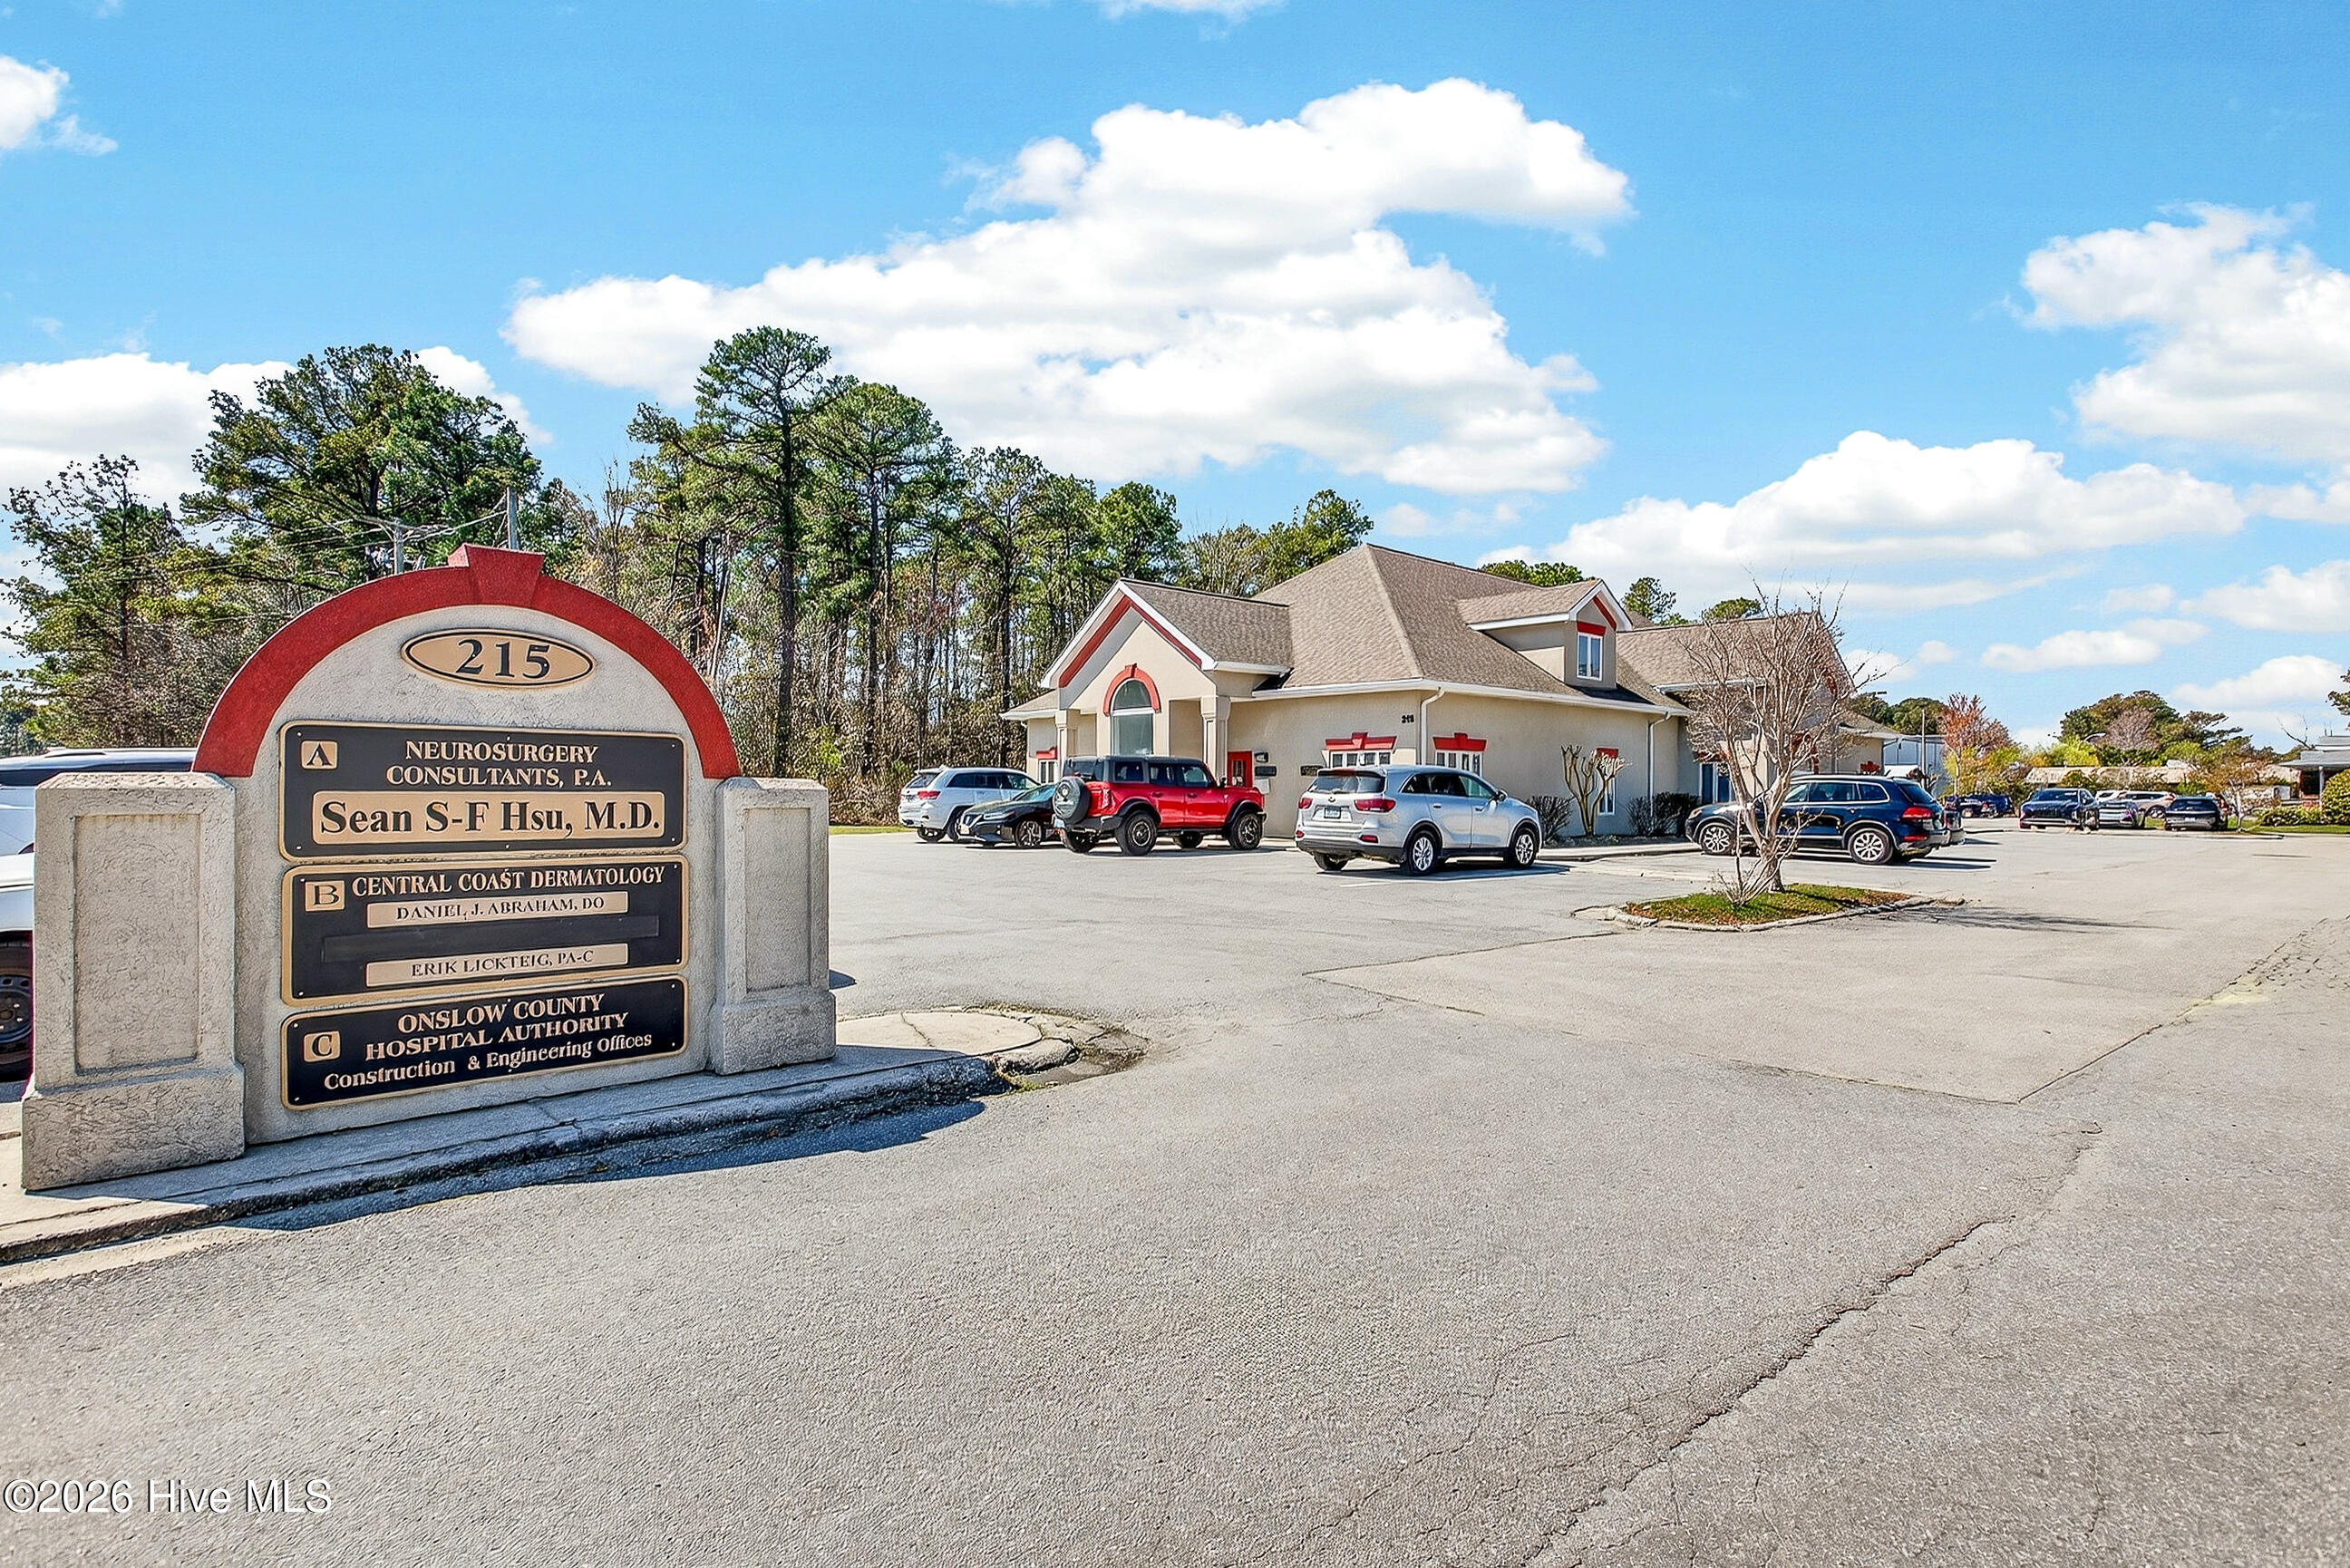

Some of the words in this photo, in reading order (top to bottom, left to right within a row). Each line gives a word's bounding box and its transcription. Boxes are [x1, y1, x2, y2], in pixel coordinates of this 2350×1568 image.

[455, 639, 550, 679] 215
[306, 744, 333, 766] A
[404, 740, 598, 764] NEUROSURGERY
[386, 766, 564, 789] CONSULTANTS,
[573, 769, 612, 786] P.A.
[320, 801, 412, 835] Sean
[425, 801, 490, 833] S-F
[500, 801, 574, 837] Hsu,
[584, 800, 660, 831] M.D.
[352, 876, 452, 897] CENTRAL
[459, 870, 525, 892] COAST
[530, 866, 666, 889] DERMATOLOGY
[313, 885, 339, 906] B
[471, 903, 484, 915] J.
[488, 898, 578, 915] ABRAHAM,
[582, 896, 605, 910] DO
[411, 961, 457, 977] ERIK
[463, 954, 553, 973] LICKTEIG,
[558, 950, 594, 966] PA-C
[398, 1004, 508, 1034] ONSLOW
[514, 994, 605, 1021] COUNTY
[312, 1035, 333, 1057] C
[364, 1031, 492, 1060] HOSPITAL
[499, 1013, 628, 1043] AUTHORITY
[325, 1060, 455, 1090] Construction
[469, 1055, 480, 1070] &
[486, 1041, 592, 1070] Engineering
[597, 1034, 653, 1051] Offices
